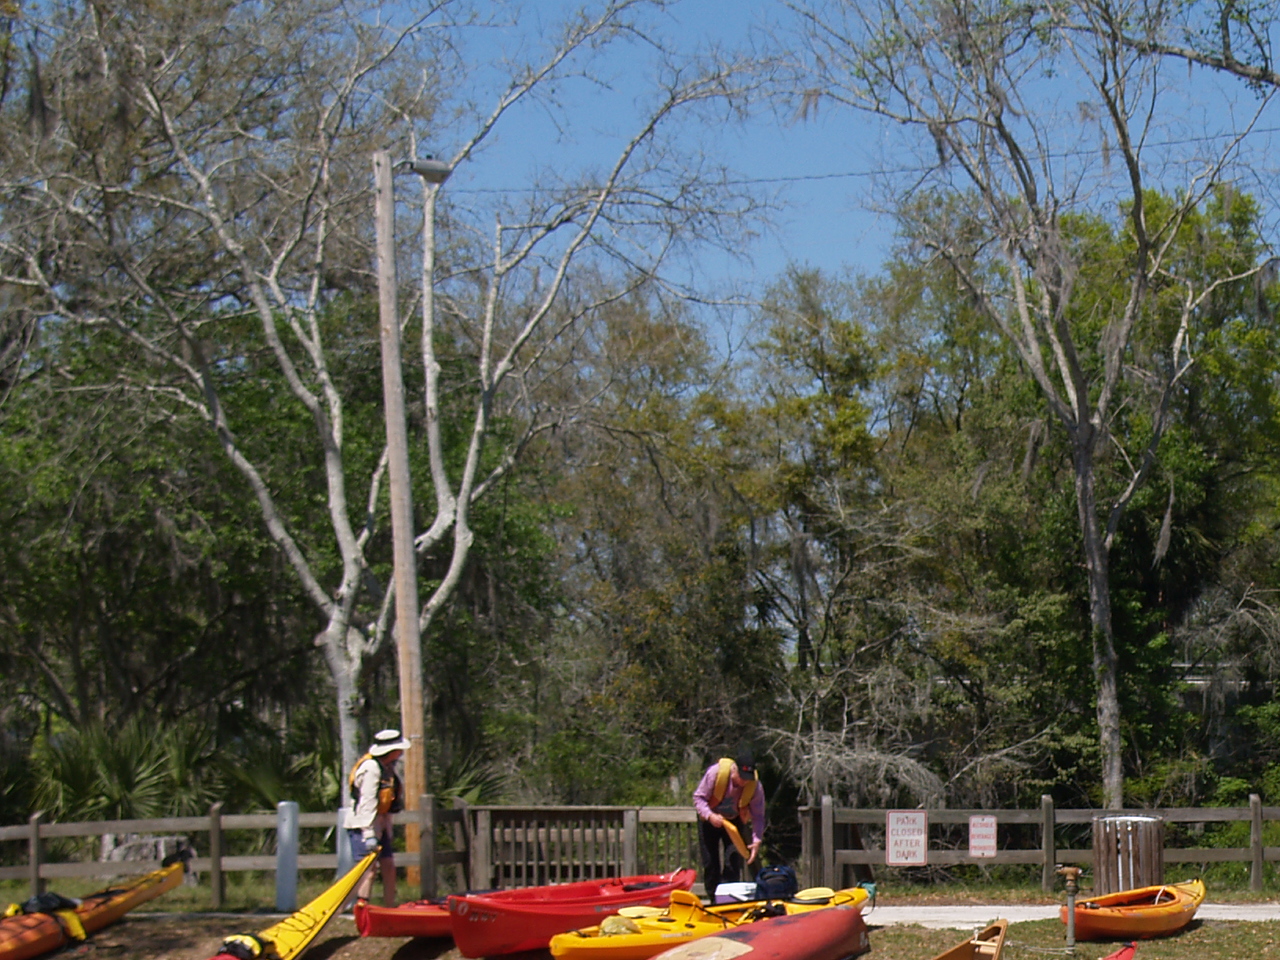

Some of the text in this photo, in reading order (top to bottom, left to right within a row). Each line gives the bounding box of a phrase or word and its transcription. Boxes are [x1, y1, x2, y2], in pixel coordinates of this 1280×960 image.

[896, 816, 917, 825] PARK
[891, 828, 923, 837] CLOSED
[894, 839, 920, 848] AFTER
[896, 850, 918, 858] DARK
